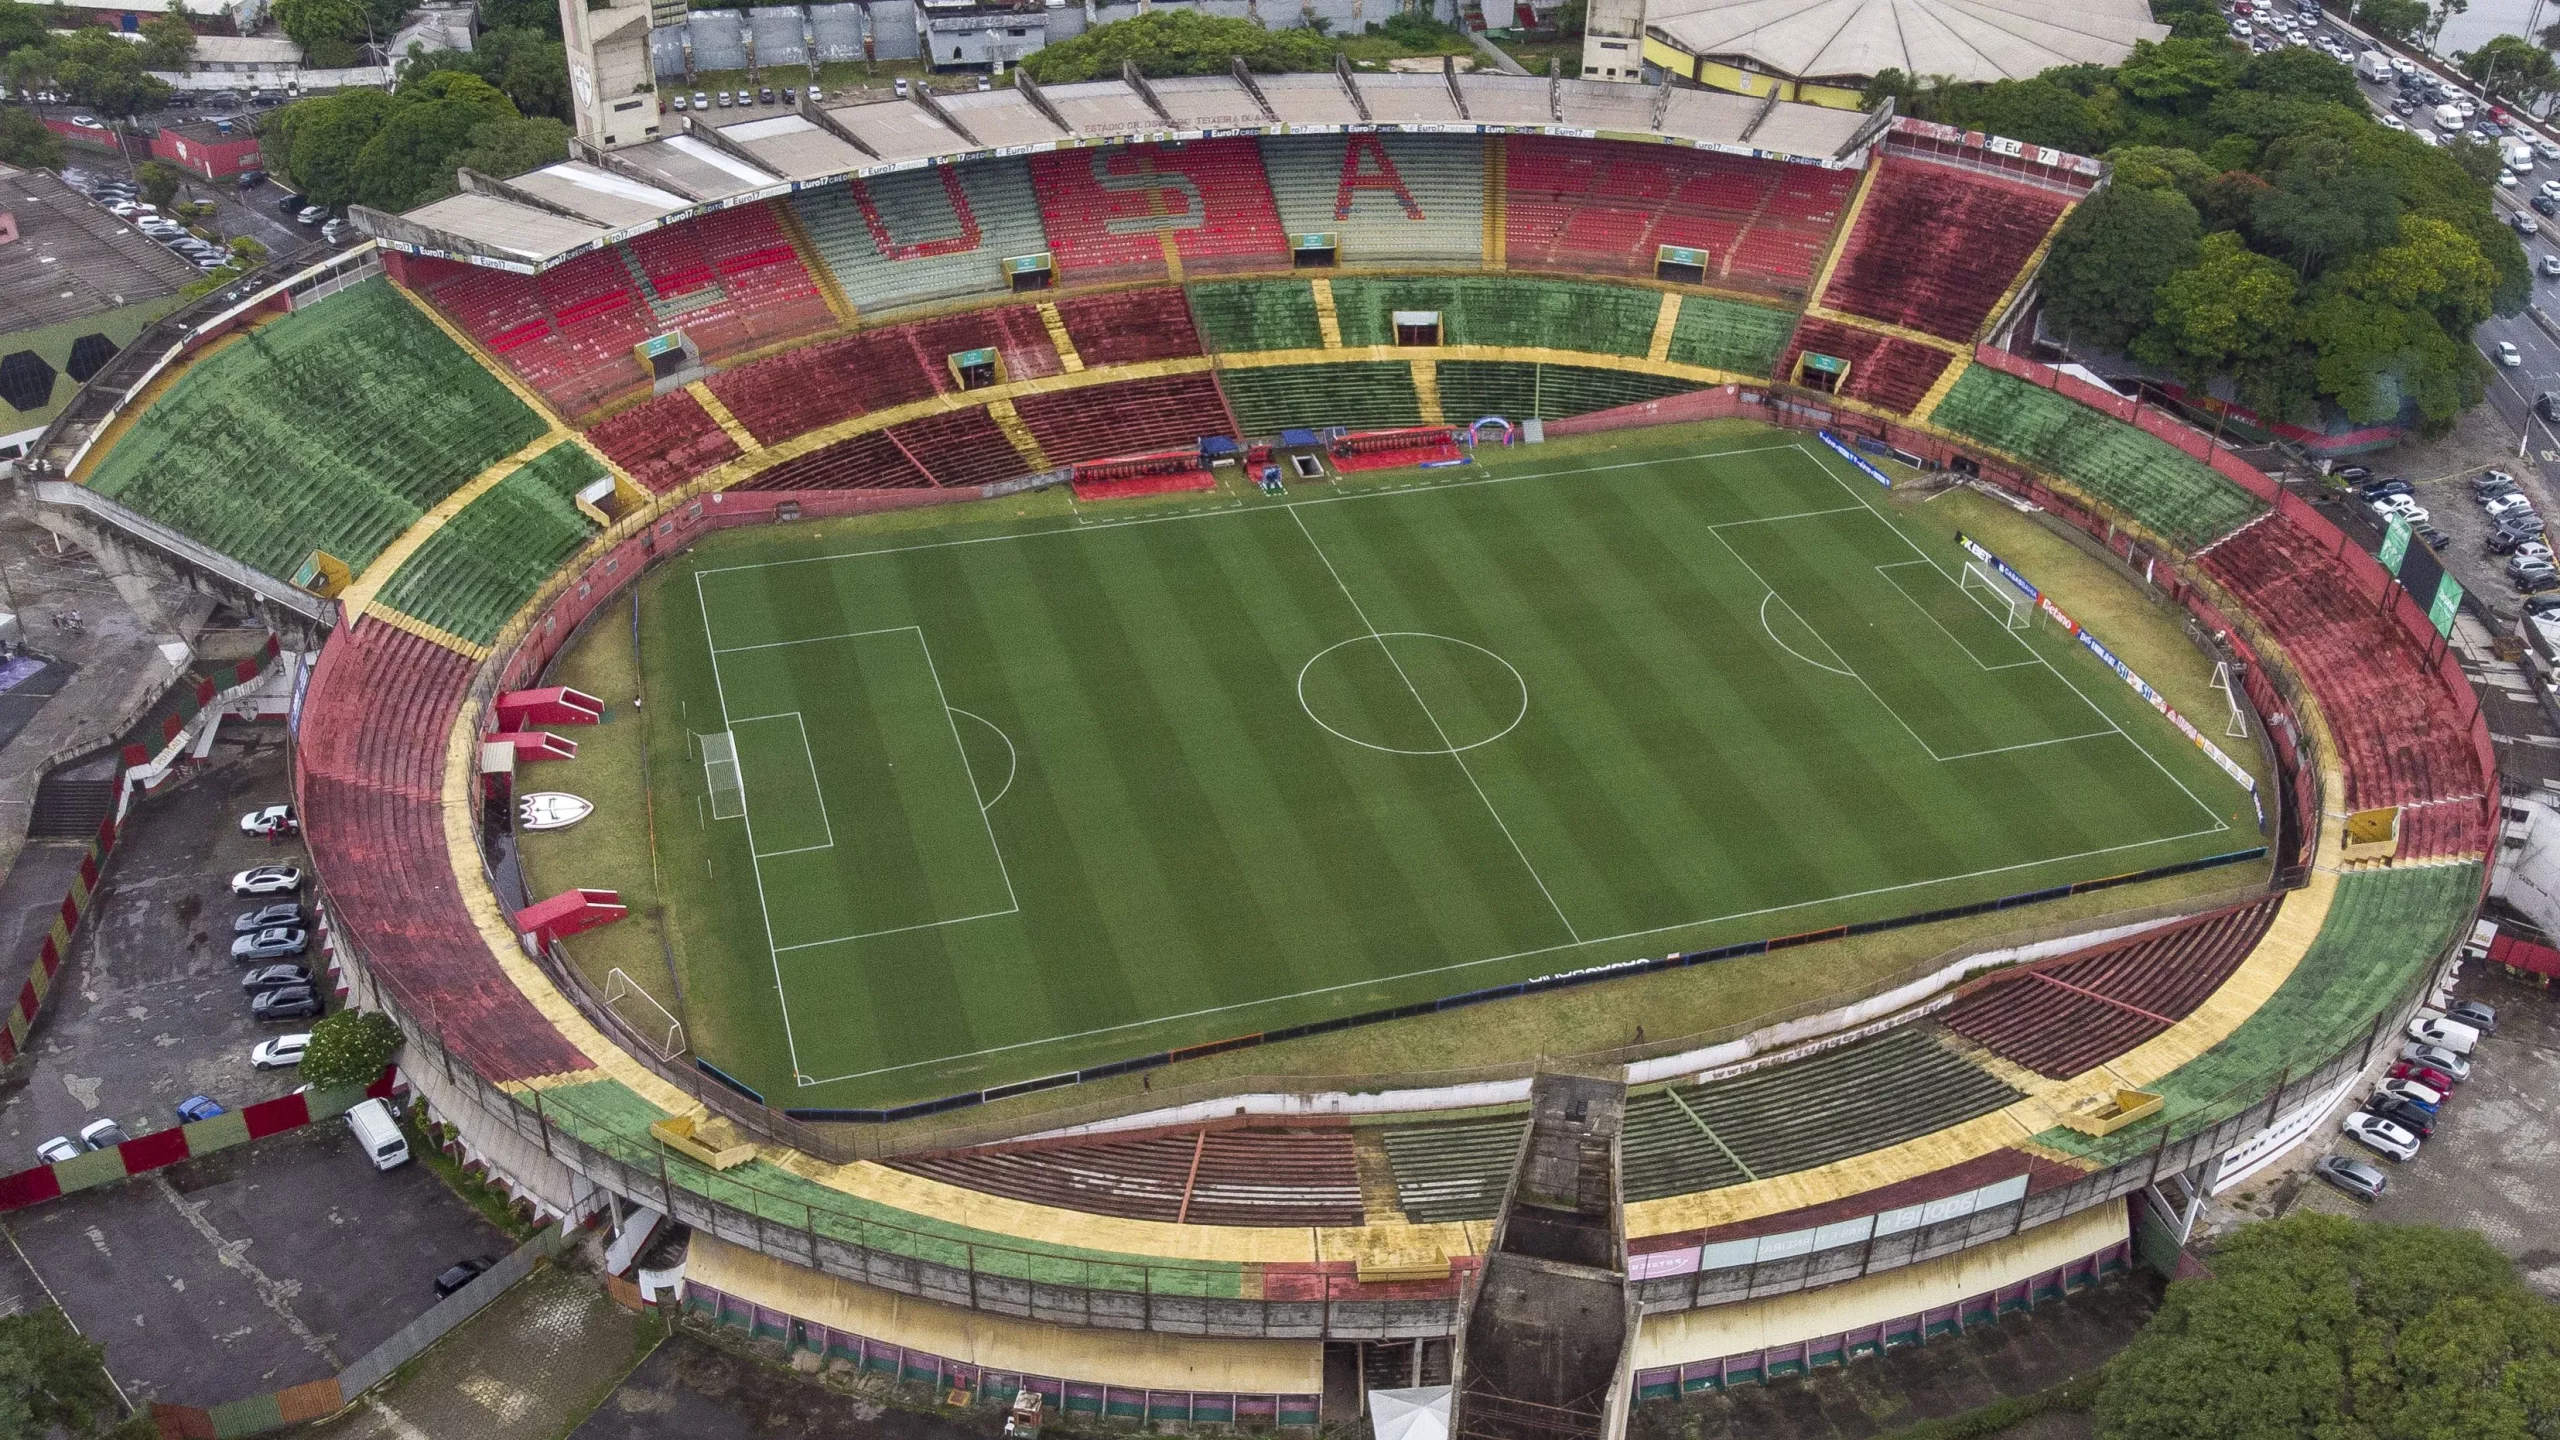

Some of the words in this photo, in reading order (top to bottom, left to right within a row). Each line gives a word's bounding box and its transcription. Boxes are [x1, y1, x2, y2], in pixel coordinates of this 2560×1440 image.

[1085, 121, 1125, 133] ESTÁDIO
[1554, 128, 1582, 137] Euro17
[1211, 129, 1240, 138] Euro17
[1006, 145, 1034, 156] Euro17
[1692, 140, 1721, 151] Euro17
[868, 164, 896, 175] Euro17
[801, 177, 828, 189] Euro17
[733, 192, 761, 206] Euro17
[665, 208, 694, 225] Euro17
[693, 202, 724, 217] CÉDITO
[420, 246, 445, 259] Euro17
[542, 252, 567, 271] Euro17
[566, 244, 594, 261] CRÉDITO
[480, 258, 506, 269] Euro17
[2043, 598, 2072, 629] Betano
